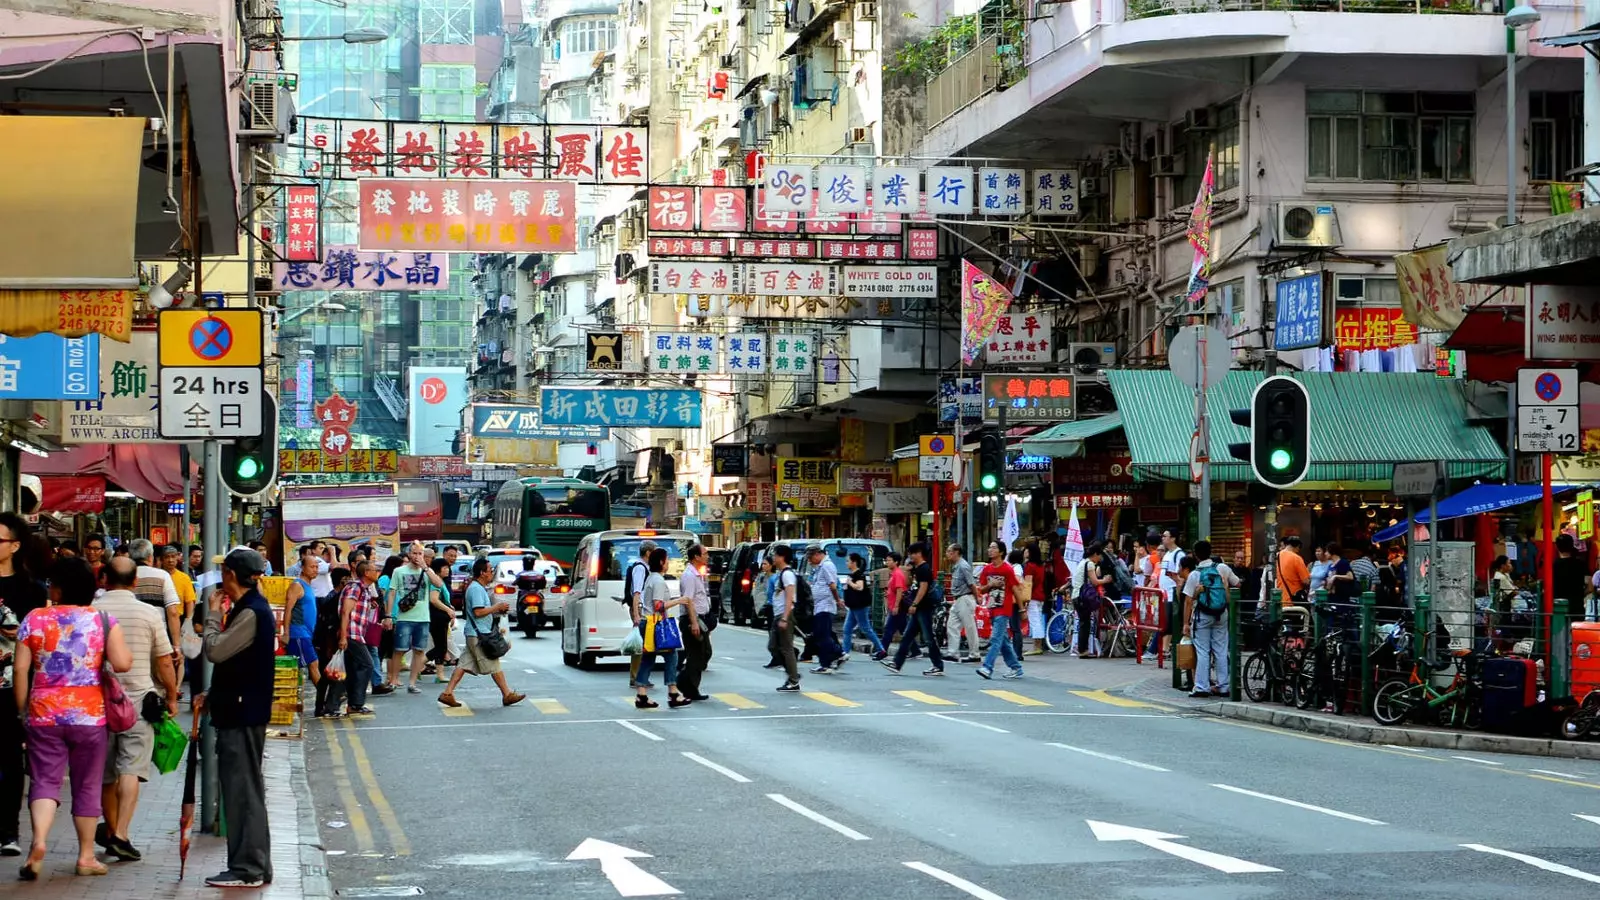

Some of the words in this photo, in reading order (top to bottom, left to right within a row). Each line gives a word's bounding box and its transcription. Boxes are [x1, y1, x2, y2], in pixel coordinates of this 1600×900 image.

[985, 173, 1022, 190] 首飾
[827, 173, 966, 207] 俊業行
[985, 193, 1022, 210] 配件
[1037, 194, 1074, 211] 用品
[913, 232, 933, 240] PAK
[665, 268, 728, 289] 白金油
[759, 269, 824, 290] 百金油
[848, 271, 879, 280] WHITE
[884, 271, 913, 281] GOLD
[917, 271, 934, 281] OIL
[58, 304, 124, 317] 23460221
[997, 316, 1041, 338] 恩平
[656, 335, 713, 351] 配料城
[1537, 334, 1556, 343] WING
[588, 361, 621, 370] GADGET
[173, 376, 205, 395] 24
[213, 376, 250, 395] hrs
[183, 402, 242, 429] 全日
[545, 390, 698, 425] 新成田影音
[1039, 408, 1071, 417] 8189
[1529, 414, 1547, 424] 上午
[1557, 408, 1567, 424] 7
[325, 431, 348, 453] 押
[1557, 433, 1576, 449] 12
[942, 471, 953, 480] 12
[556, 519, 592, 527] 23918090
